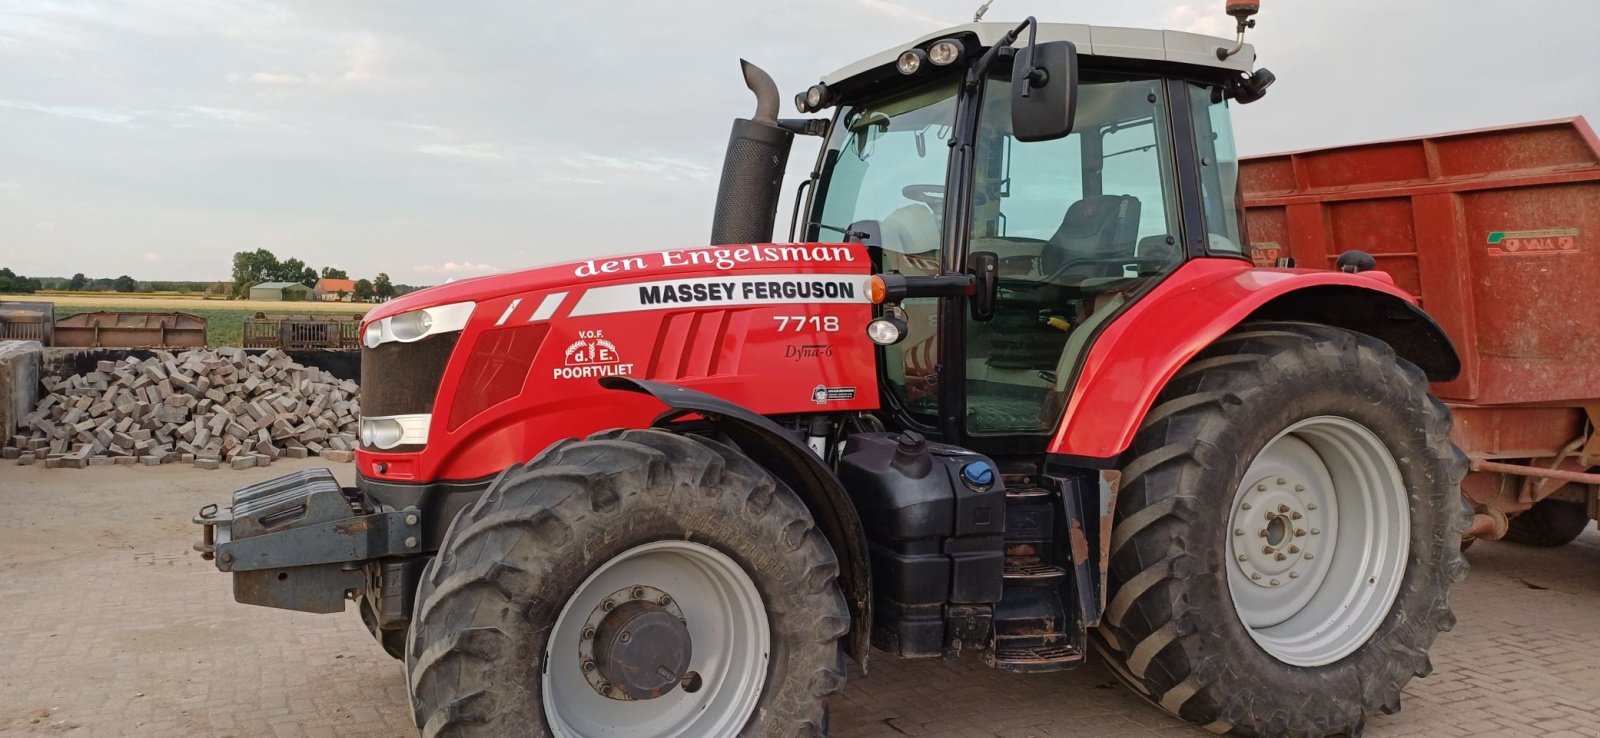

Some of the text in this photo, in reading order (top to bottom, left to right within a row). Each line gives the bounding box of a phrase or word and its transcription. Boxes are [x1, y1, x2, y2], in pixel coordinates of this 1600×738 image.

[574, 243, 854, 277] den Engelsman
[639, 281, 854, 304] MASSEY FERGUSON
[773, 315, 840, 332] 7718
[578, 330, 604, 339] V.O.F.
[574, 349, 613, 362] d. E.
[785, 344, 833, 361] Dyna-6
[553, 363, 634, 380] POORTVLIET
